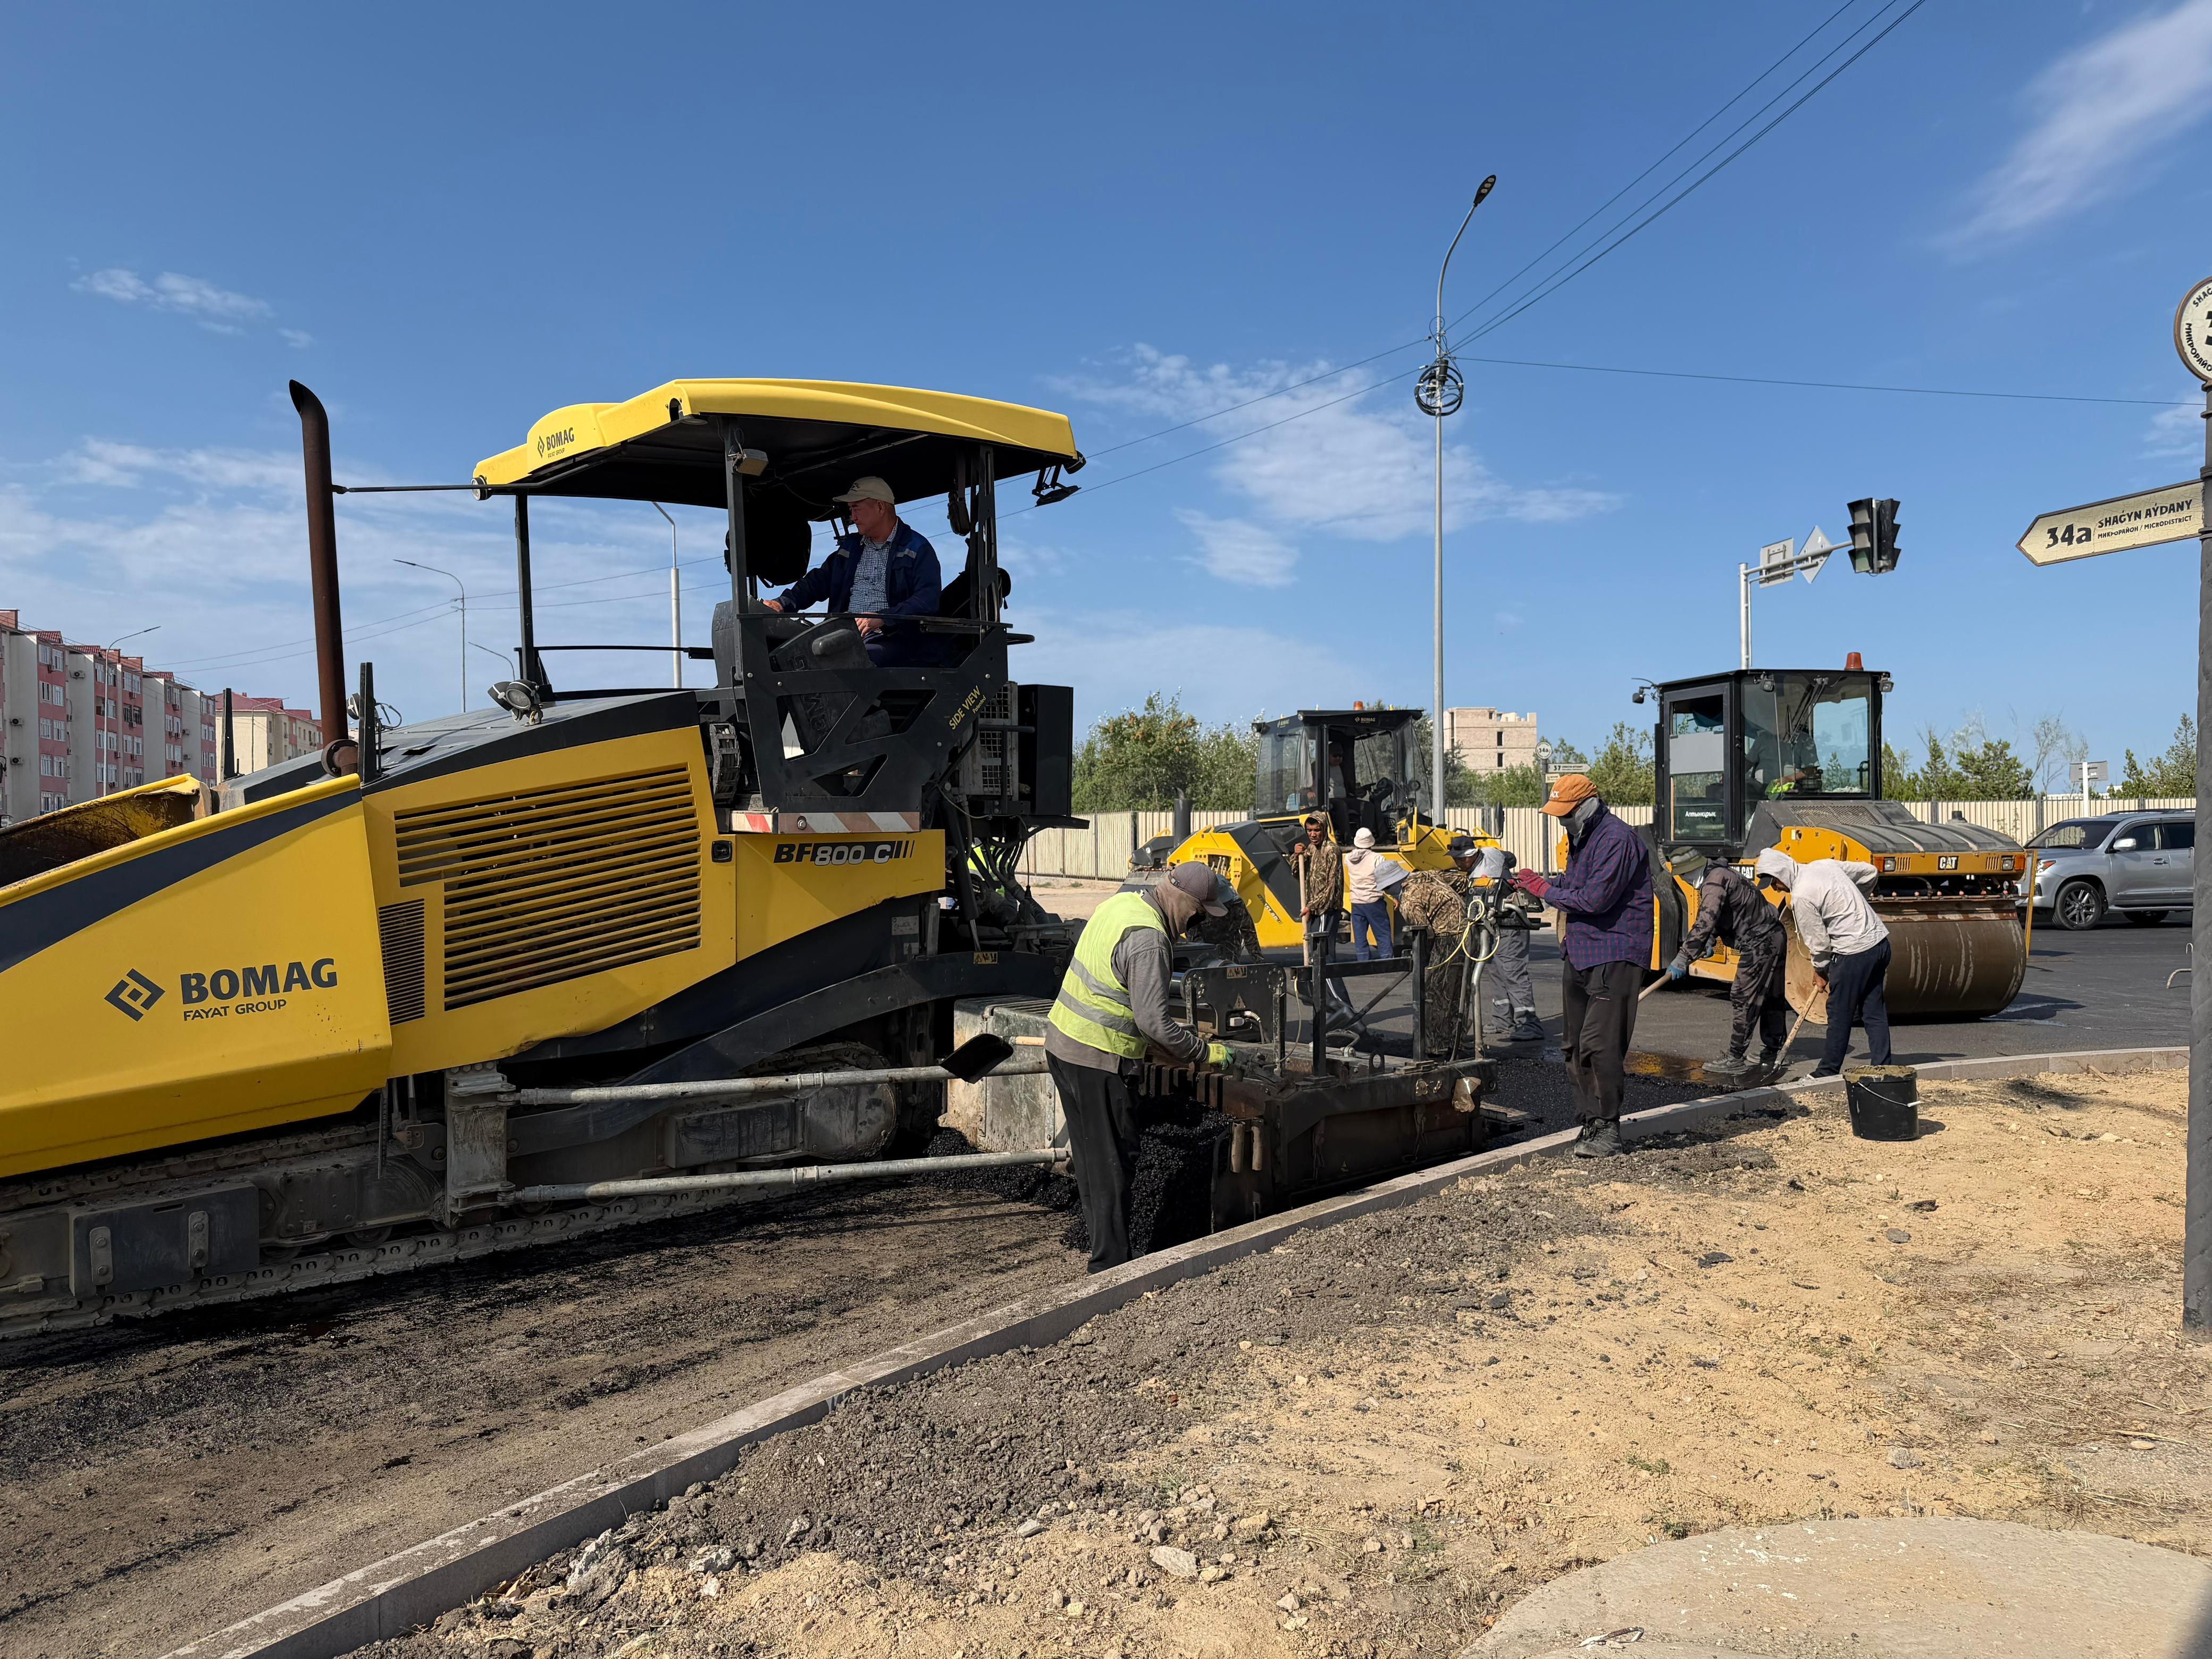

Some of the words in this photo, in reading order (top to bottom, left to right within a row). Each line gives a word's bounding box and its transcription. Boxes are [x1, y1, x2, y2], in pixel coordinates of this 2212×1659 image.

[546, 427, 574, 451] BOMAG
[2046, 523, 2091, 549] 34a
[2098, 526, 2138, 539] МИКРОРАЙОН
[2144, 515, 2192, 530] MICRODISTRICT
[949, 708, 965, 730] SIDE
[962, 685, 981, 710] VIEW
[1741, 866, 1754, 878] CAT
[1940, 857, 1957, 869] CAT
[180, 958, 338, 1004] BOMAG
[183, 1006, 230, 1021] FAYAT
[235, 999, 287, 1014] GROUP
